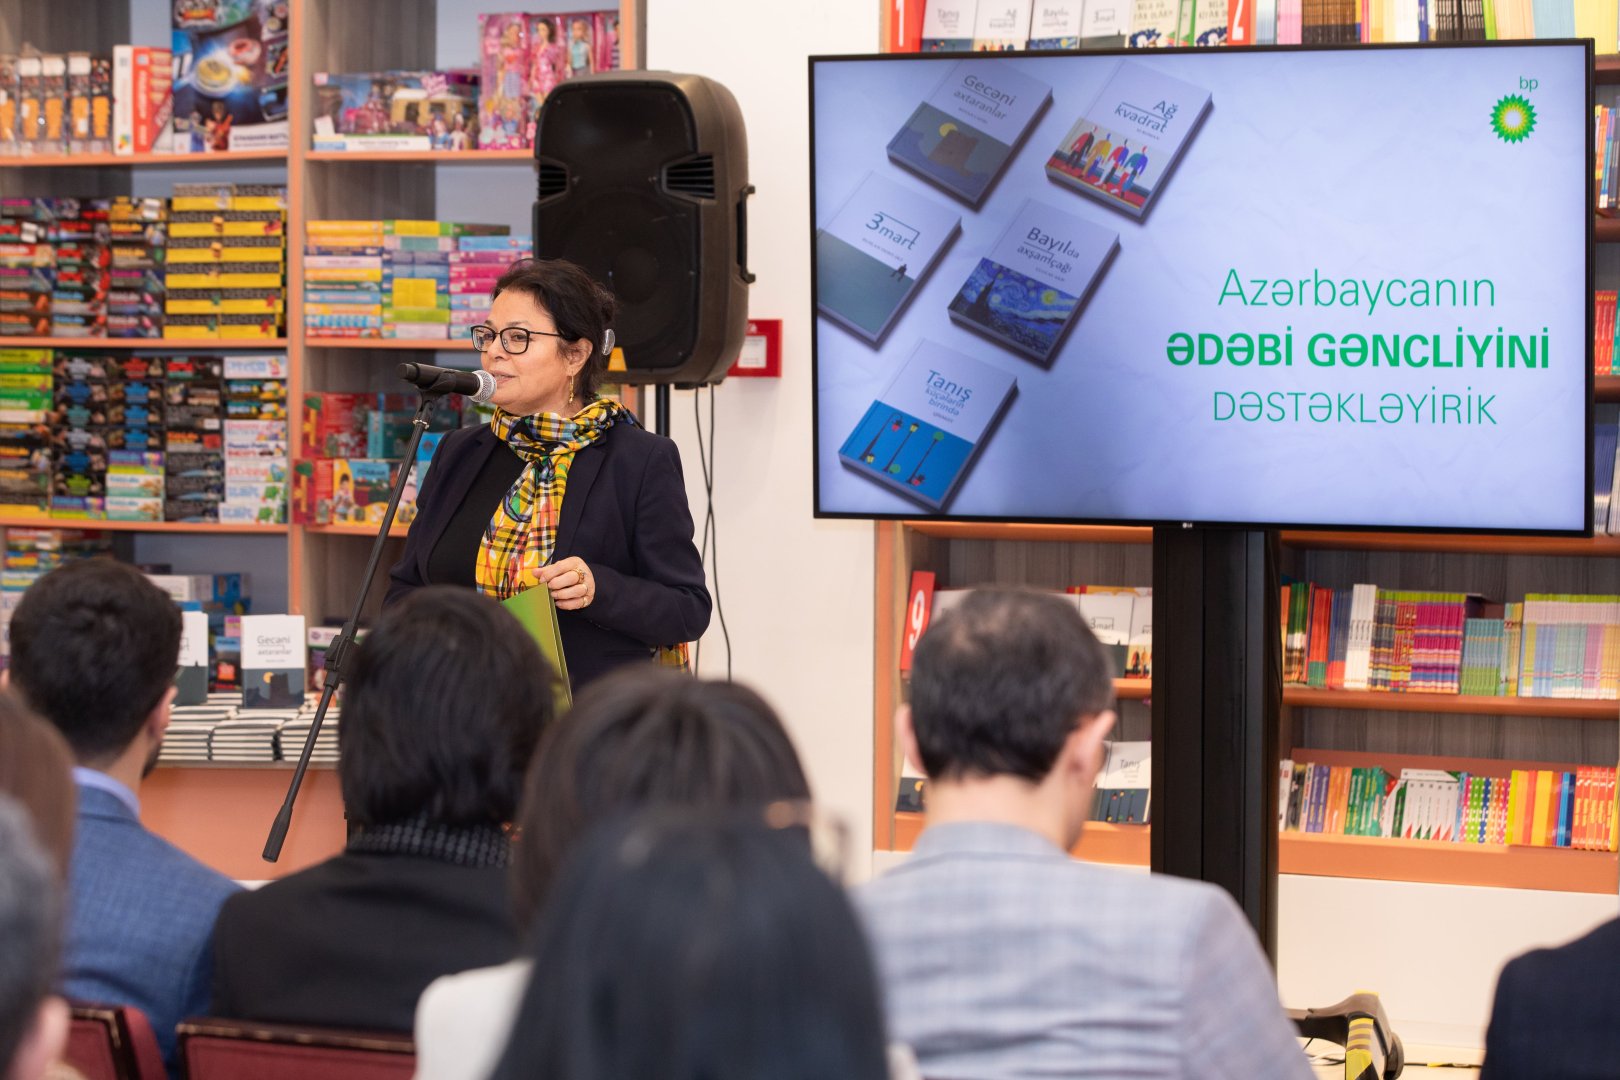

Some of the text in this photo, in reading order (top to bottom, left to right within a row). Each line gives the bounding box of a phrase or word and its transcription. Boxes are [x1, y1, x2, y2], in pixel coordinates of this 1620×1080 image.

[964, 74, 1017, 106] Gecəni
[1519, 75, 1539, 93] bp
[953, 90, 1007, 120] axtaranlar
[1114, 103, 1168, 133] kvadrat
[1152, 100, 1178, 120] Ağ
[1217, 268, 1496, 316] Azərbaycanın
[1166, 325, 1549, 369] ƏDƏBİ GƏNCLİYİNİ
[927, 369, 973, 402] Tanış
[1213, 386, 1498, 425] DƏSTƏKLƏYİRİK
[908, 589, 925, 651] 9
